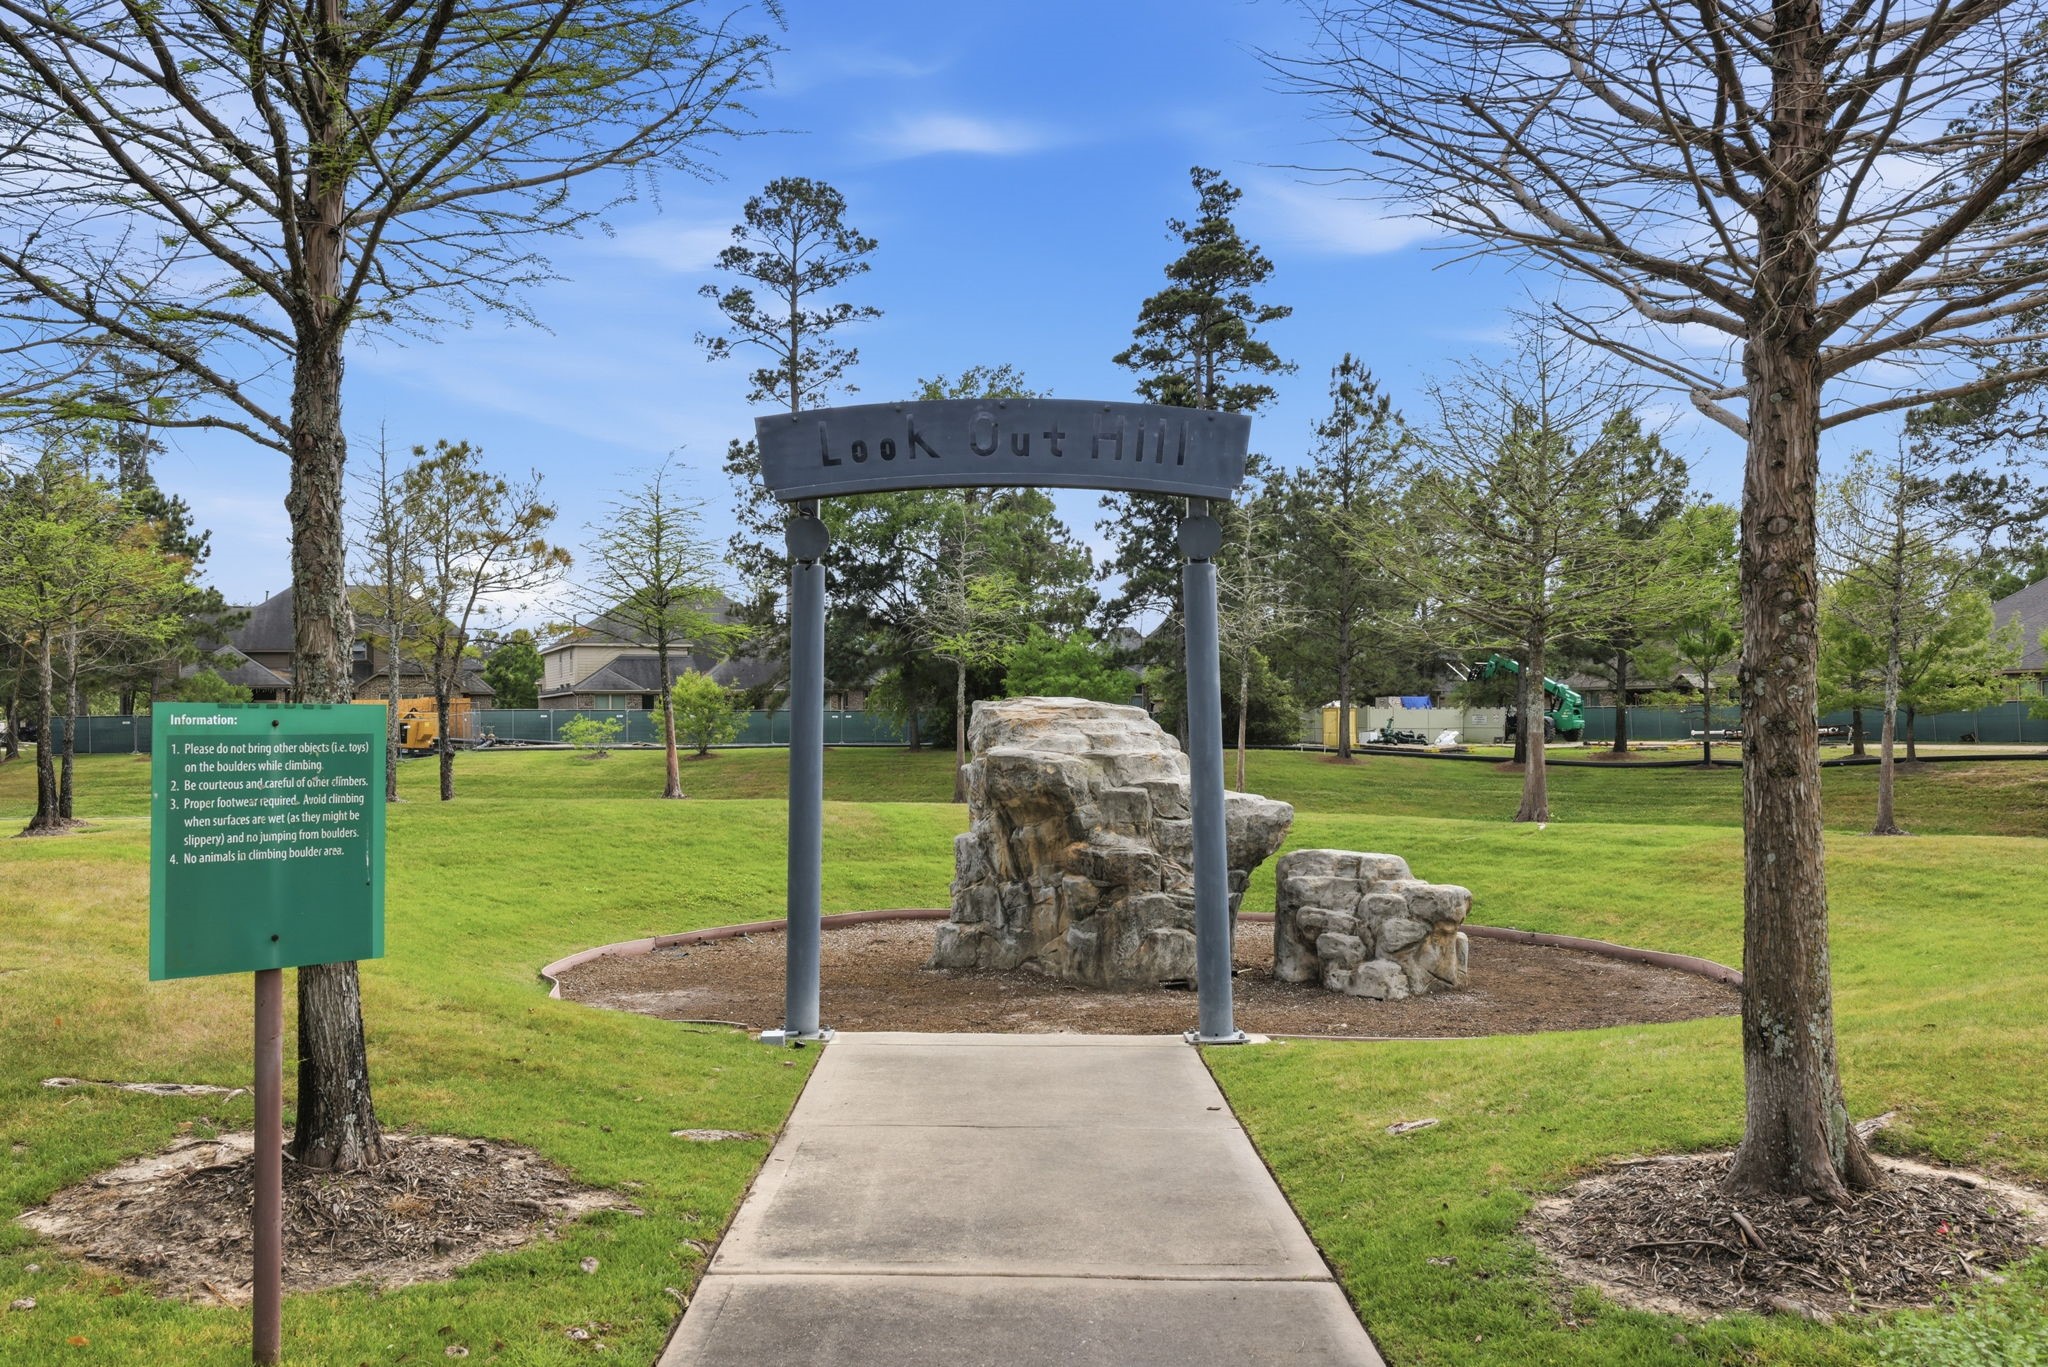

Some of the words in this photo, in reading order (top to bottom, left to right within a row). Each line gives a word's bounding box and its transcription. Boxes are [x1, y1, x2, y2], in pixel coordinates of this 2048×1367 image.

[969, 411, 1066, 458] Out
[1091, 413, 1188, 466] Hill
[170, 714, 238, 725] Information:
[171, 743, 180, 754] 1.
[184, 743, 215, 754] Please
[216, 743, 229, 754] do
[230, 744, 246, 754] not
[248, 743, 272, 756] bring
[273, 742, 297, 753] other
[299, 742, 330, 755] objects
[331, 742, 347, 754] (i.e.
[349, 742, 369, 754] toys)
[184, 764, 197, 773] on
[199, 761, 215, 772] the
[217, 761, 256, 772] boulders
[258, 760, 283, 771] while
[170, 780, 180, 791] 2.
[184, 780, 197, 791] Be
[198, 779, 244, 790] courteous
[245, 778, 263, 790] and
[264, 777, 294, 788] careful
[296, 777, 306, 788] of
[307, 776, 329, 787] other
[331, 776, 368, 787] climbers.
[170, 798, 179, 810] 3.
[184, 798, 215, 811] Proper
[217, 797, 258, 808] footwear
[303, 793, 327, 805] Avoid
[328, 793, 364, 806] climbing
[184, 816, 211, 827] when
[212, 814, 250, 826] surfaces
[251, 815, 266, 825] are
[268, 814, 285, 823] wet
[287, 812, 300, 824] (as
[301, 811, 320, 824] they
[322, 810, 347, 823] might
[349, 810, 360, 820] be
[184, 833, 225, 848] slippery)
[227, 832, 244, 844] and
[246, 833, 258, 843] no
[259, 831, 297, 844] jumping
[299, 829, 319, 840] from
[321, 827, 359, 839] boulders.
[169, 854, 179, 865] 4.
[184, 853, 197, 864] No
[199, 850, 235, 863] animals
[237, 850, 246, 861] in
[248, 848, 287, 861] climbing
[289, 846, 322, 858] boulder
[323, 847, 344, 856] area.
